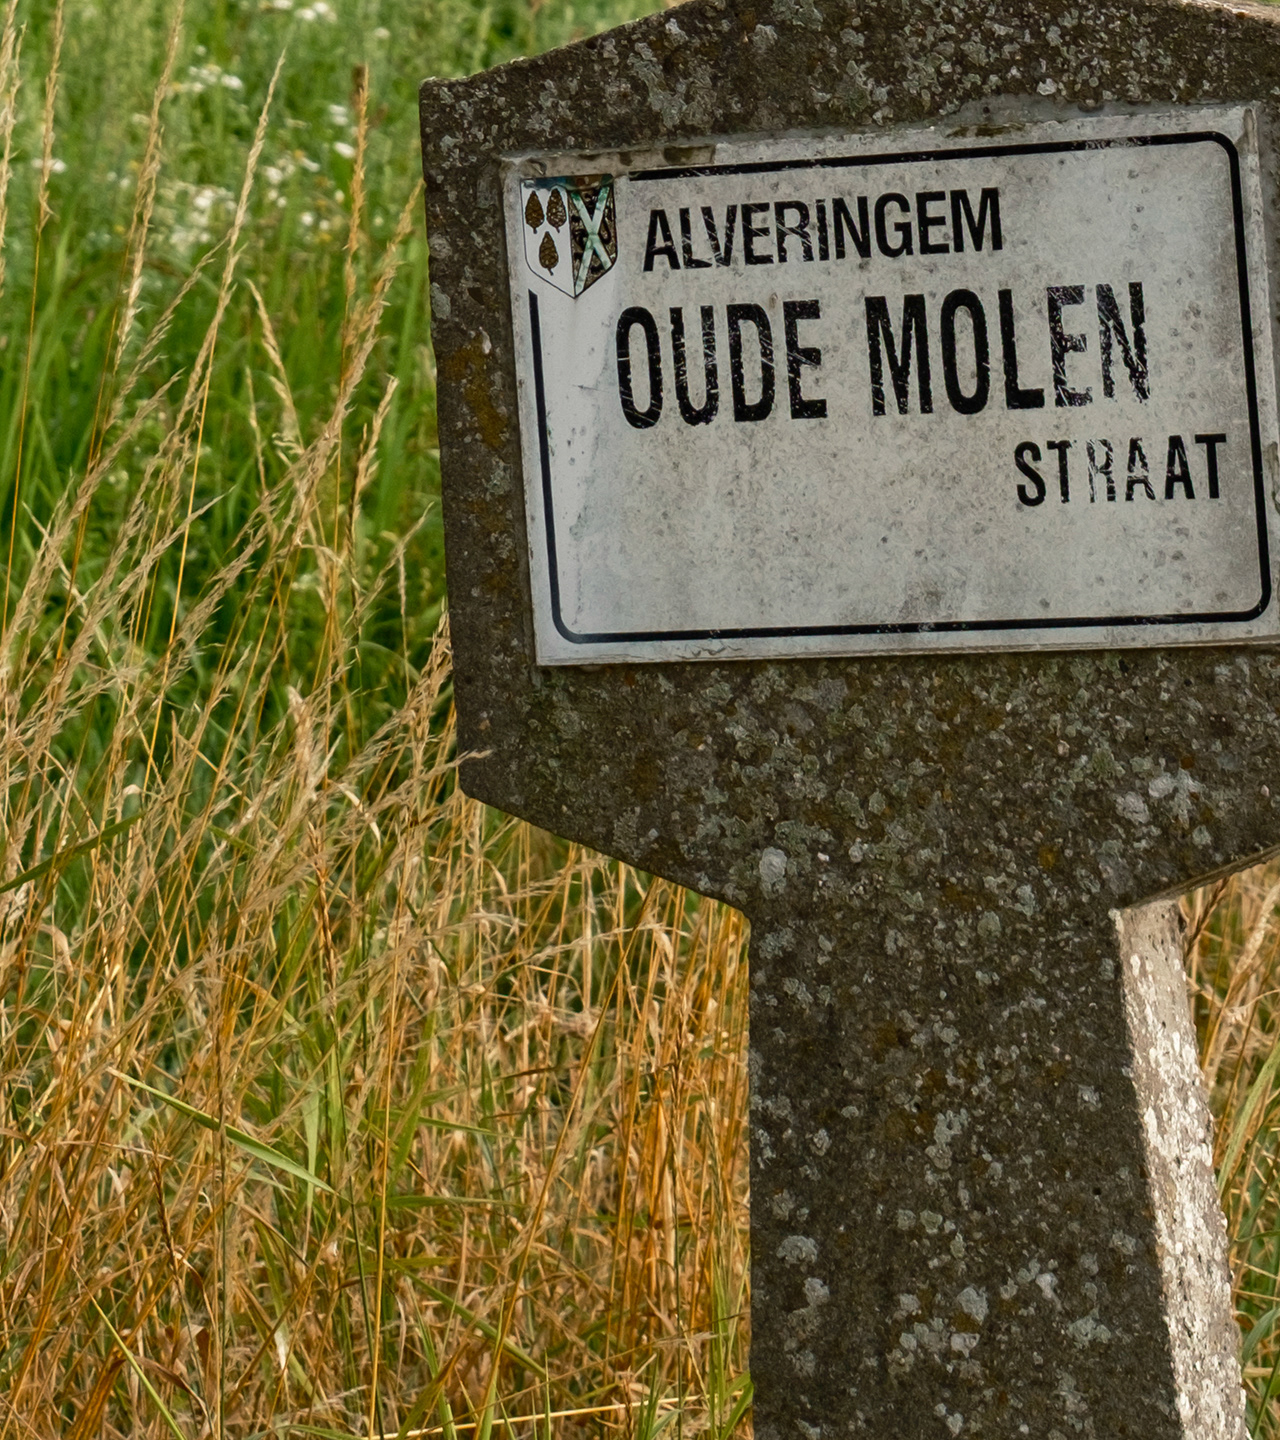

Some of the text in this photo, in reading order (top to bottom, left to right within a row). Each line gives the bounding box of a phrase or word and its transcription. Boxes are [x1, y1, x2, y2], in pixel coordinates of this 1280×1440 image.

[642, 187, 1004, 272] ALVERINGEM
[615, 281, 1150, 429] OUDE MOLEN
[1014, 432, 1227, 508] STRAAT
